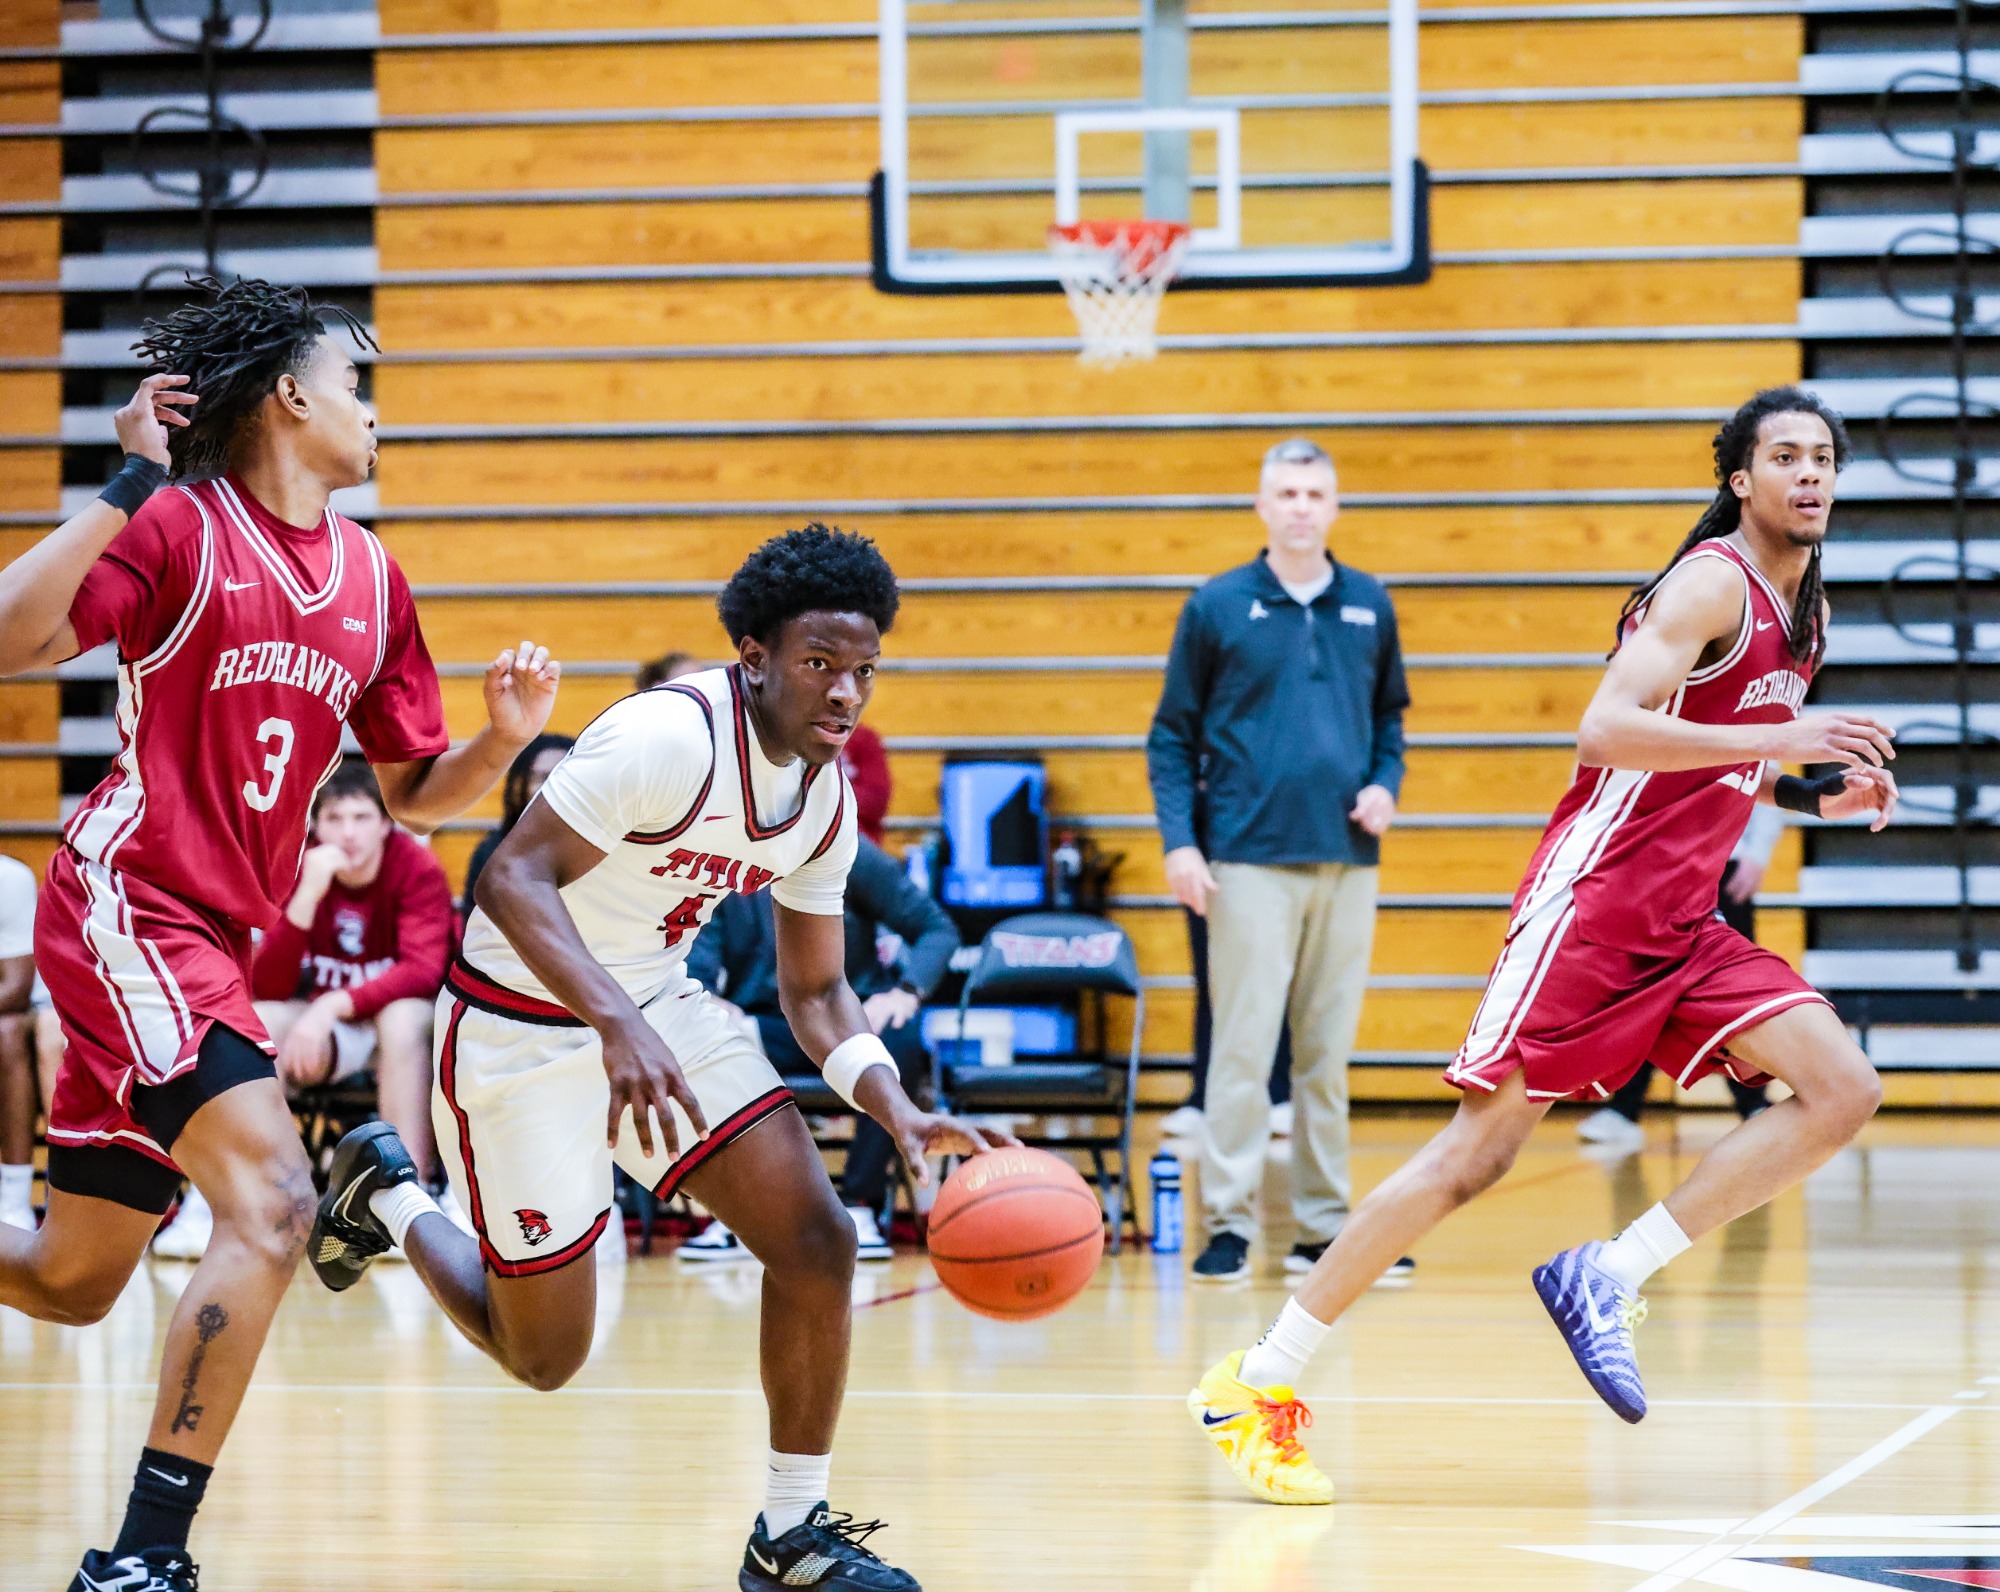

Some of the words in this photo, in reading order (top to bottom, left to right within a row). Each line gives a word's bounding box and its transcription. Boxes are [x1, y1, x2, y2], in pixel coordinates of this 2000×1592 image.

[209, 641, 358, 722] REDHAWKS
[1733, 669, 1809, 720] REDHAWK
[242, 716, 295, 813] 3
[649, 847, 785, 897] TITAN
[656, 893, 718, 949] 4
[991, 931, 1123, 968] TITANS
